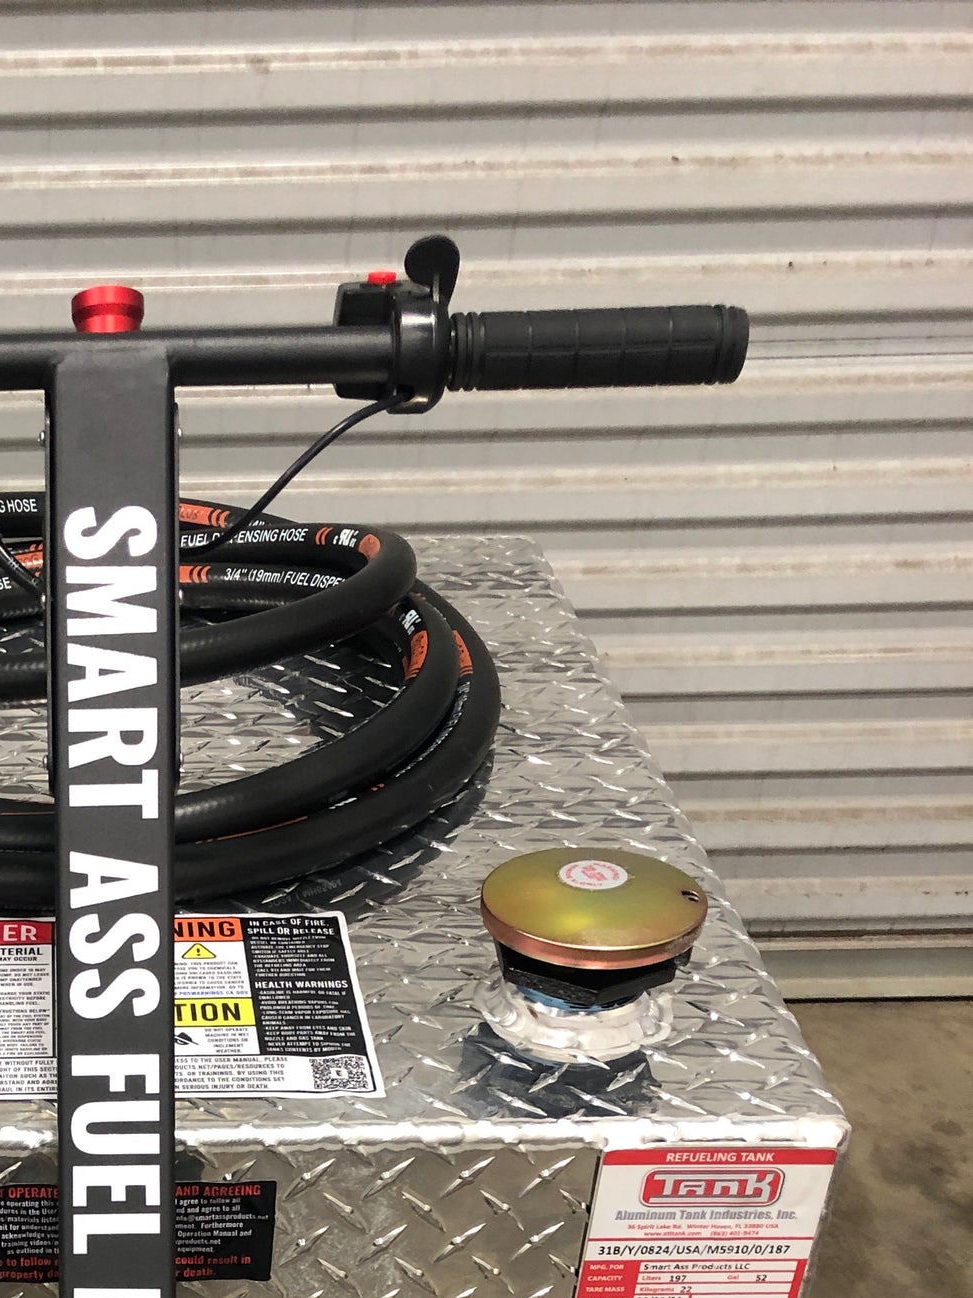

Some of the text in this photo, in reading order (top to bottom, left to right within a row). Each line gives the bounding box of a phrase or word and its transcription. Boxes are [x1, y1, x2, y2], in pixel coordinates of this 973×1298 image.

[9, 499, 37, 513] HOSE
[181, 528, 308, 547] FUEL HOSE
[284, 571, 310, 587] FUEL
[63, 505, 159, 819] SMART
[290, 918, 302, 926] OF
[68, 851, 161, 1019] ASS
[277, 927, 290, 935] OR
[255, 980, 348, 988] HEALTH WARNINGS
[70, 1053, 161, 1255] FUEL
[666, 1152, 775, 1163] REFUELING TANK
[8, 1187, 59, 1199] OPERATE
[175, 1186, 199, 1196] AND
[203, 1185, 261, 1196] AGREEING
[6, 1200, 39, 1208] operating
[615, 1209, 798, 1221] Aluminum Tank Industries, Inc.
[597, 1245, 791, 1256] 31B/Y/0824/USA/M5910/0/187
[6, 1258, 17, 1266] to
[20, 1257, 51, 1266] follow
[175, 1256, 204, 1265] could
[208, 1255, 238, 1264] result
[240, 1256, 251, 1264] in
[0, 1270, 44, 1280] property
[669, 1275, 687, 1283] 197
[755, 1274, 768, 1282] 52
